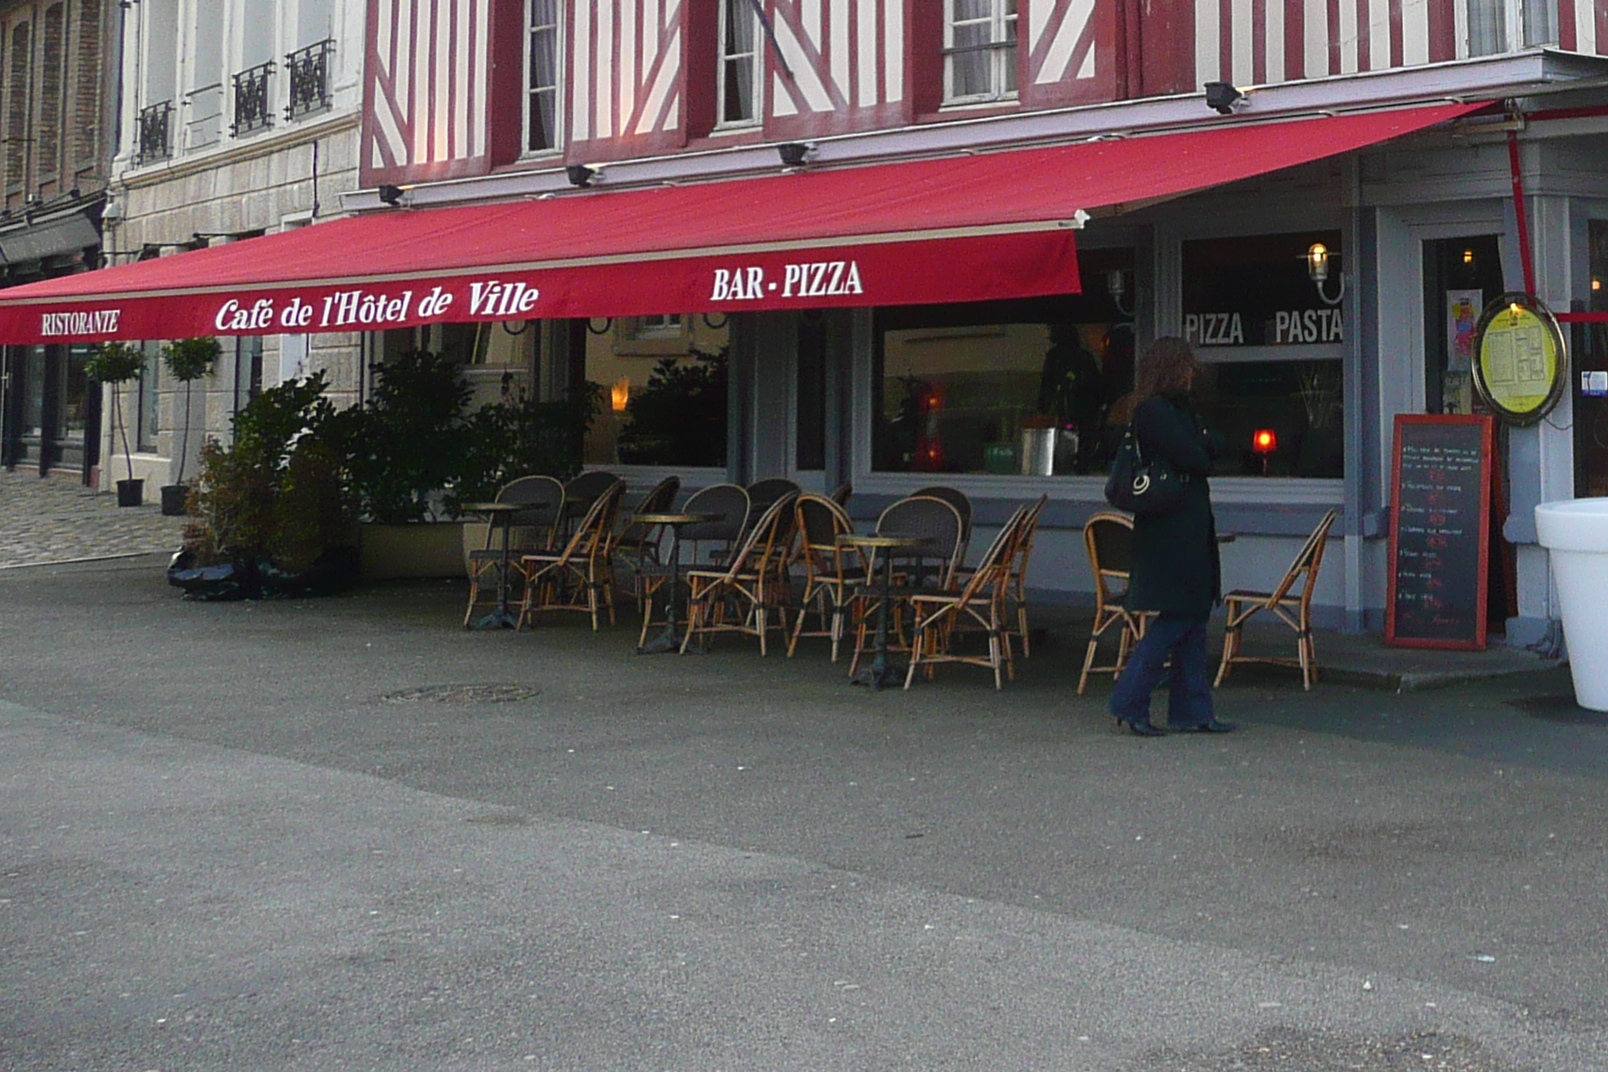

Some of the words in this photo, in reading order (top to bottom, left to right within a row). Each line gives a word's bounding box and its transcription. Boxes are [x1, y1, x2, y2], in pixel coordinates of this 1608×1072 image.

[710, 266, 764, 301] BAR
[781, 260, 864, 298] PIZZA
[41, 309, 121, 336] RISTORANTE
[215, 298, 274, 331] Café
[281, 297, 313, 327] de
[319, 289, 413, 328] l'Hôtel
[418, 286, 453, 318] de
[469, 280, 540, 316] Ville
[1185, 312, 1244, 345] PIZZA
[1275, 308, 1344, 344] PASTA
